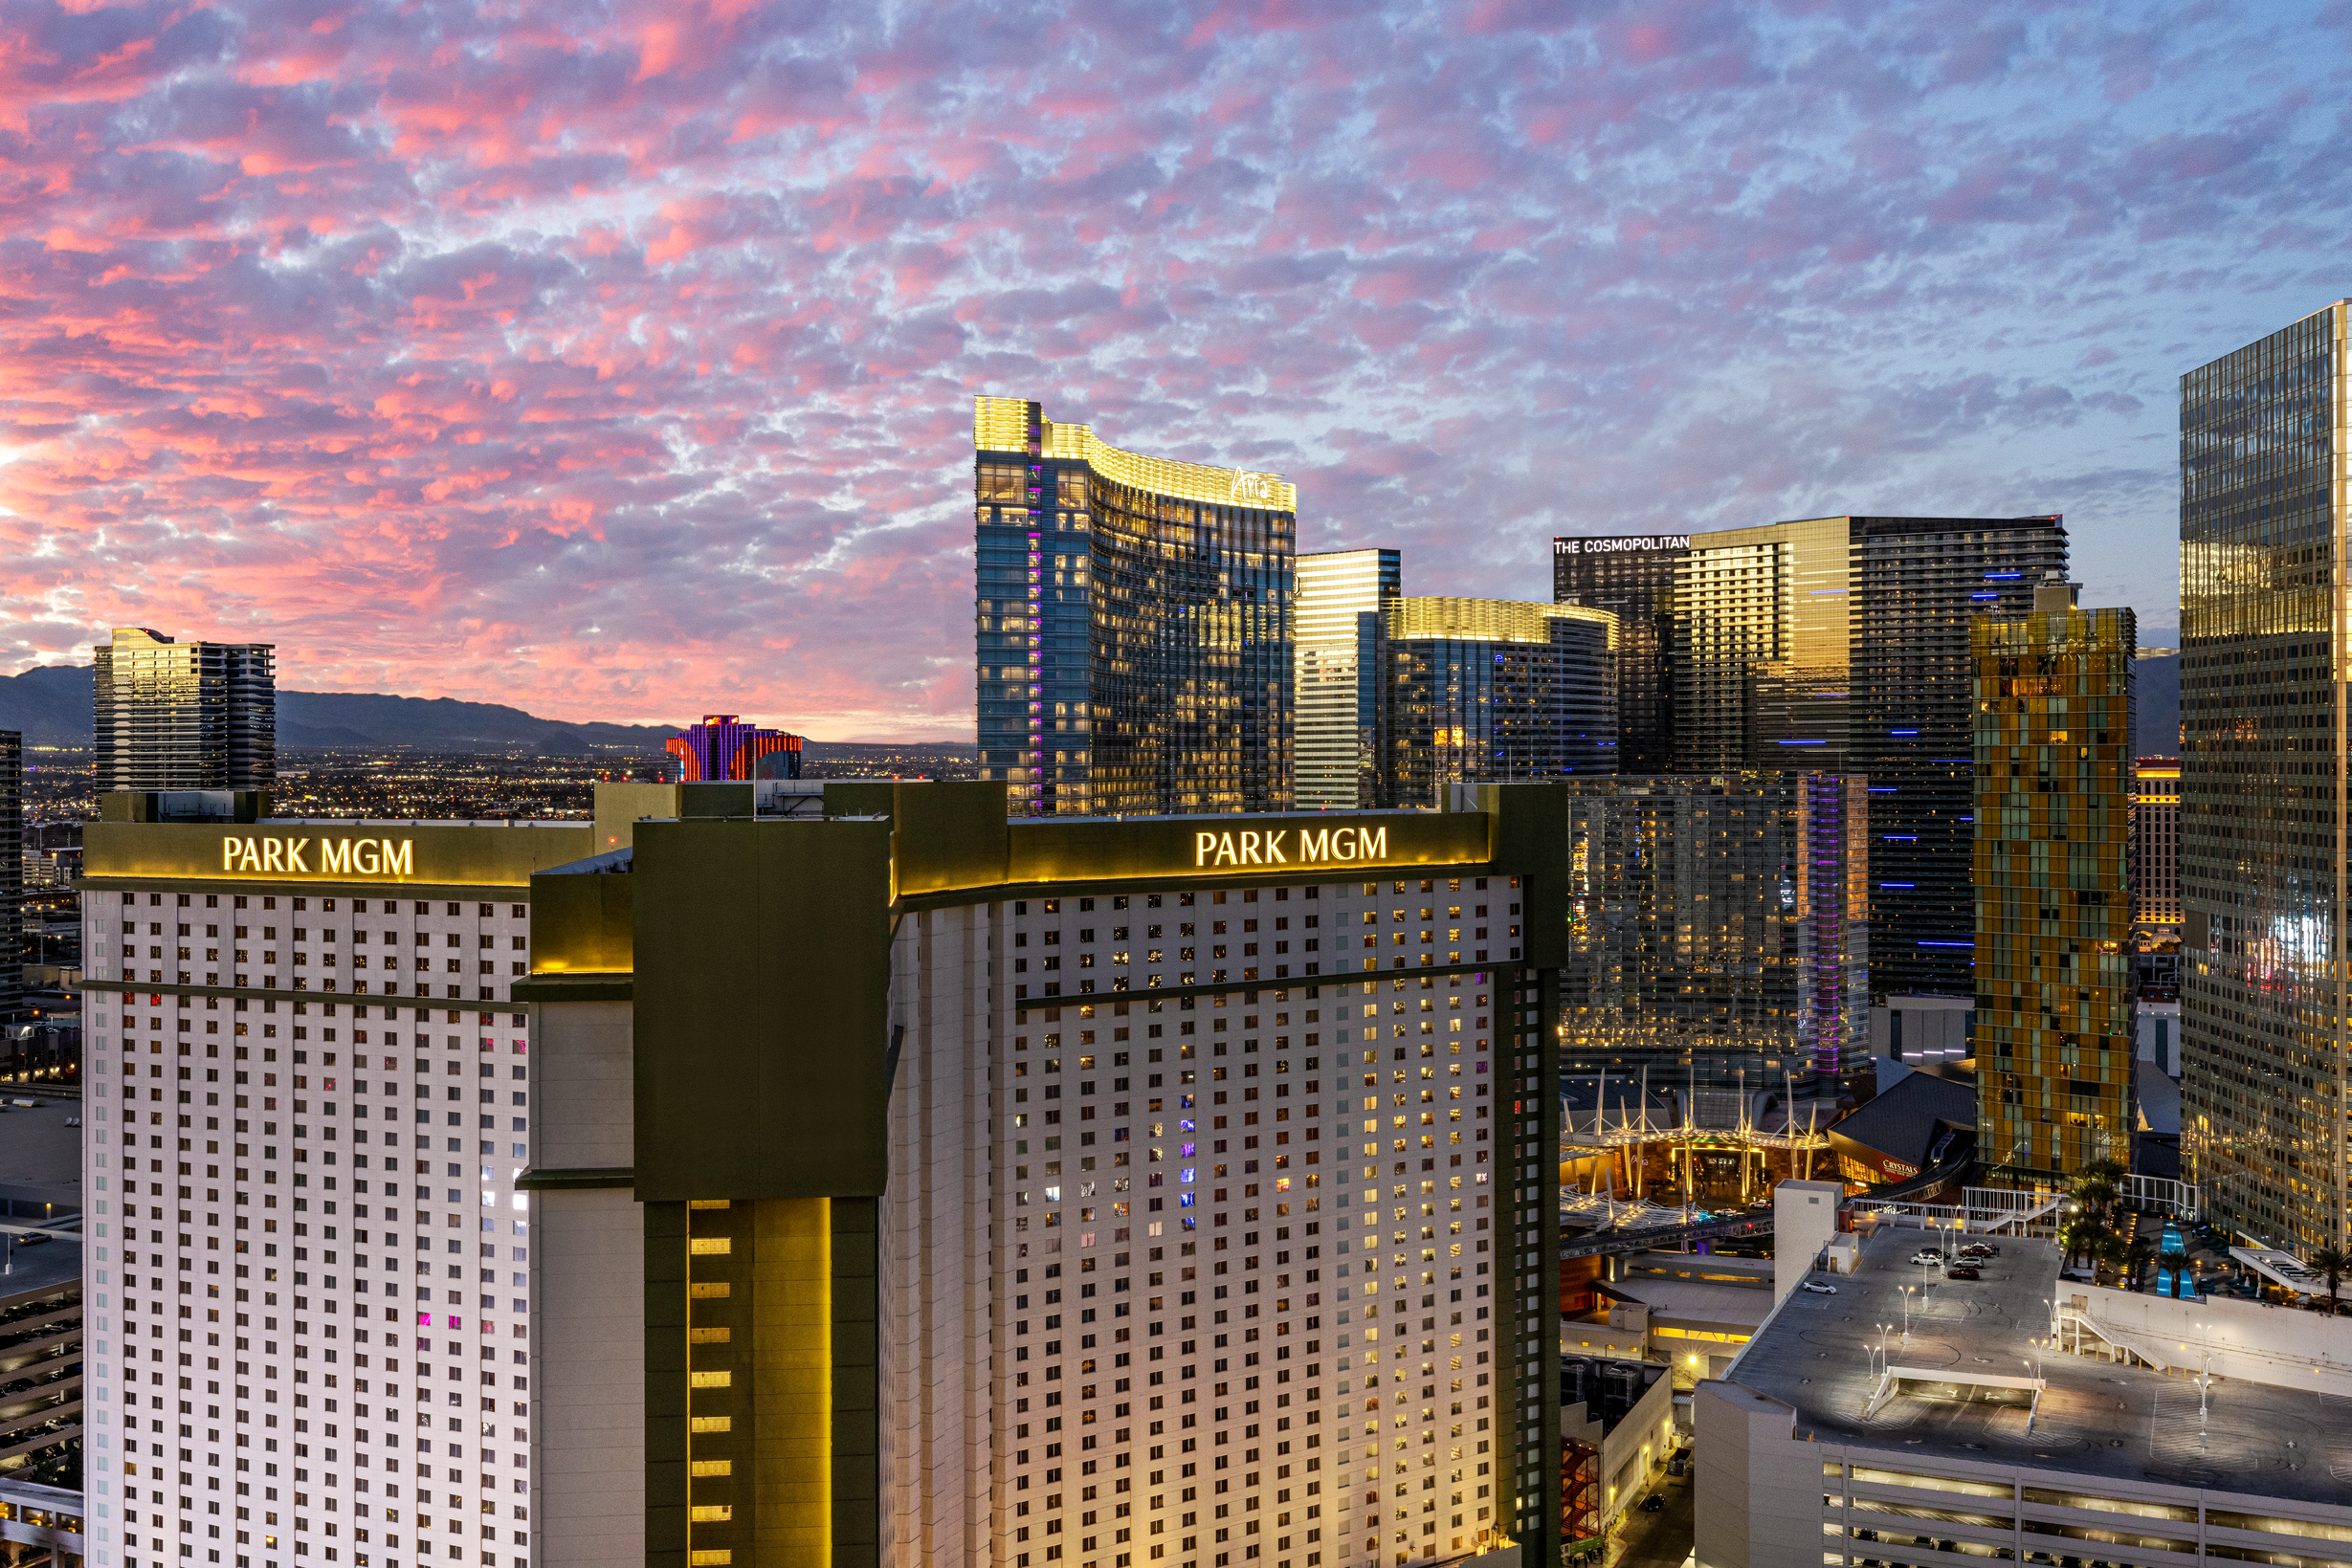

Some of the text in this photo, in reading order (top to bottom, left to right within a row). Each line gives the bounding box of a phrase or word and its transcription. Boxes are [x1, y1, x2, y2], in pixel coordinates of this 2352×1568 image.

[1231, 466, 1268, 499] Aria
[1554, 536, 1690, 554] THE COSMOPOLITAN
[224, 837, 413, 874] PARK MGM
[1196, 827, 1387, 867] PARK MGM
[1883, 1159, 1918, 1174] CRYSTALS
